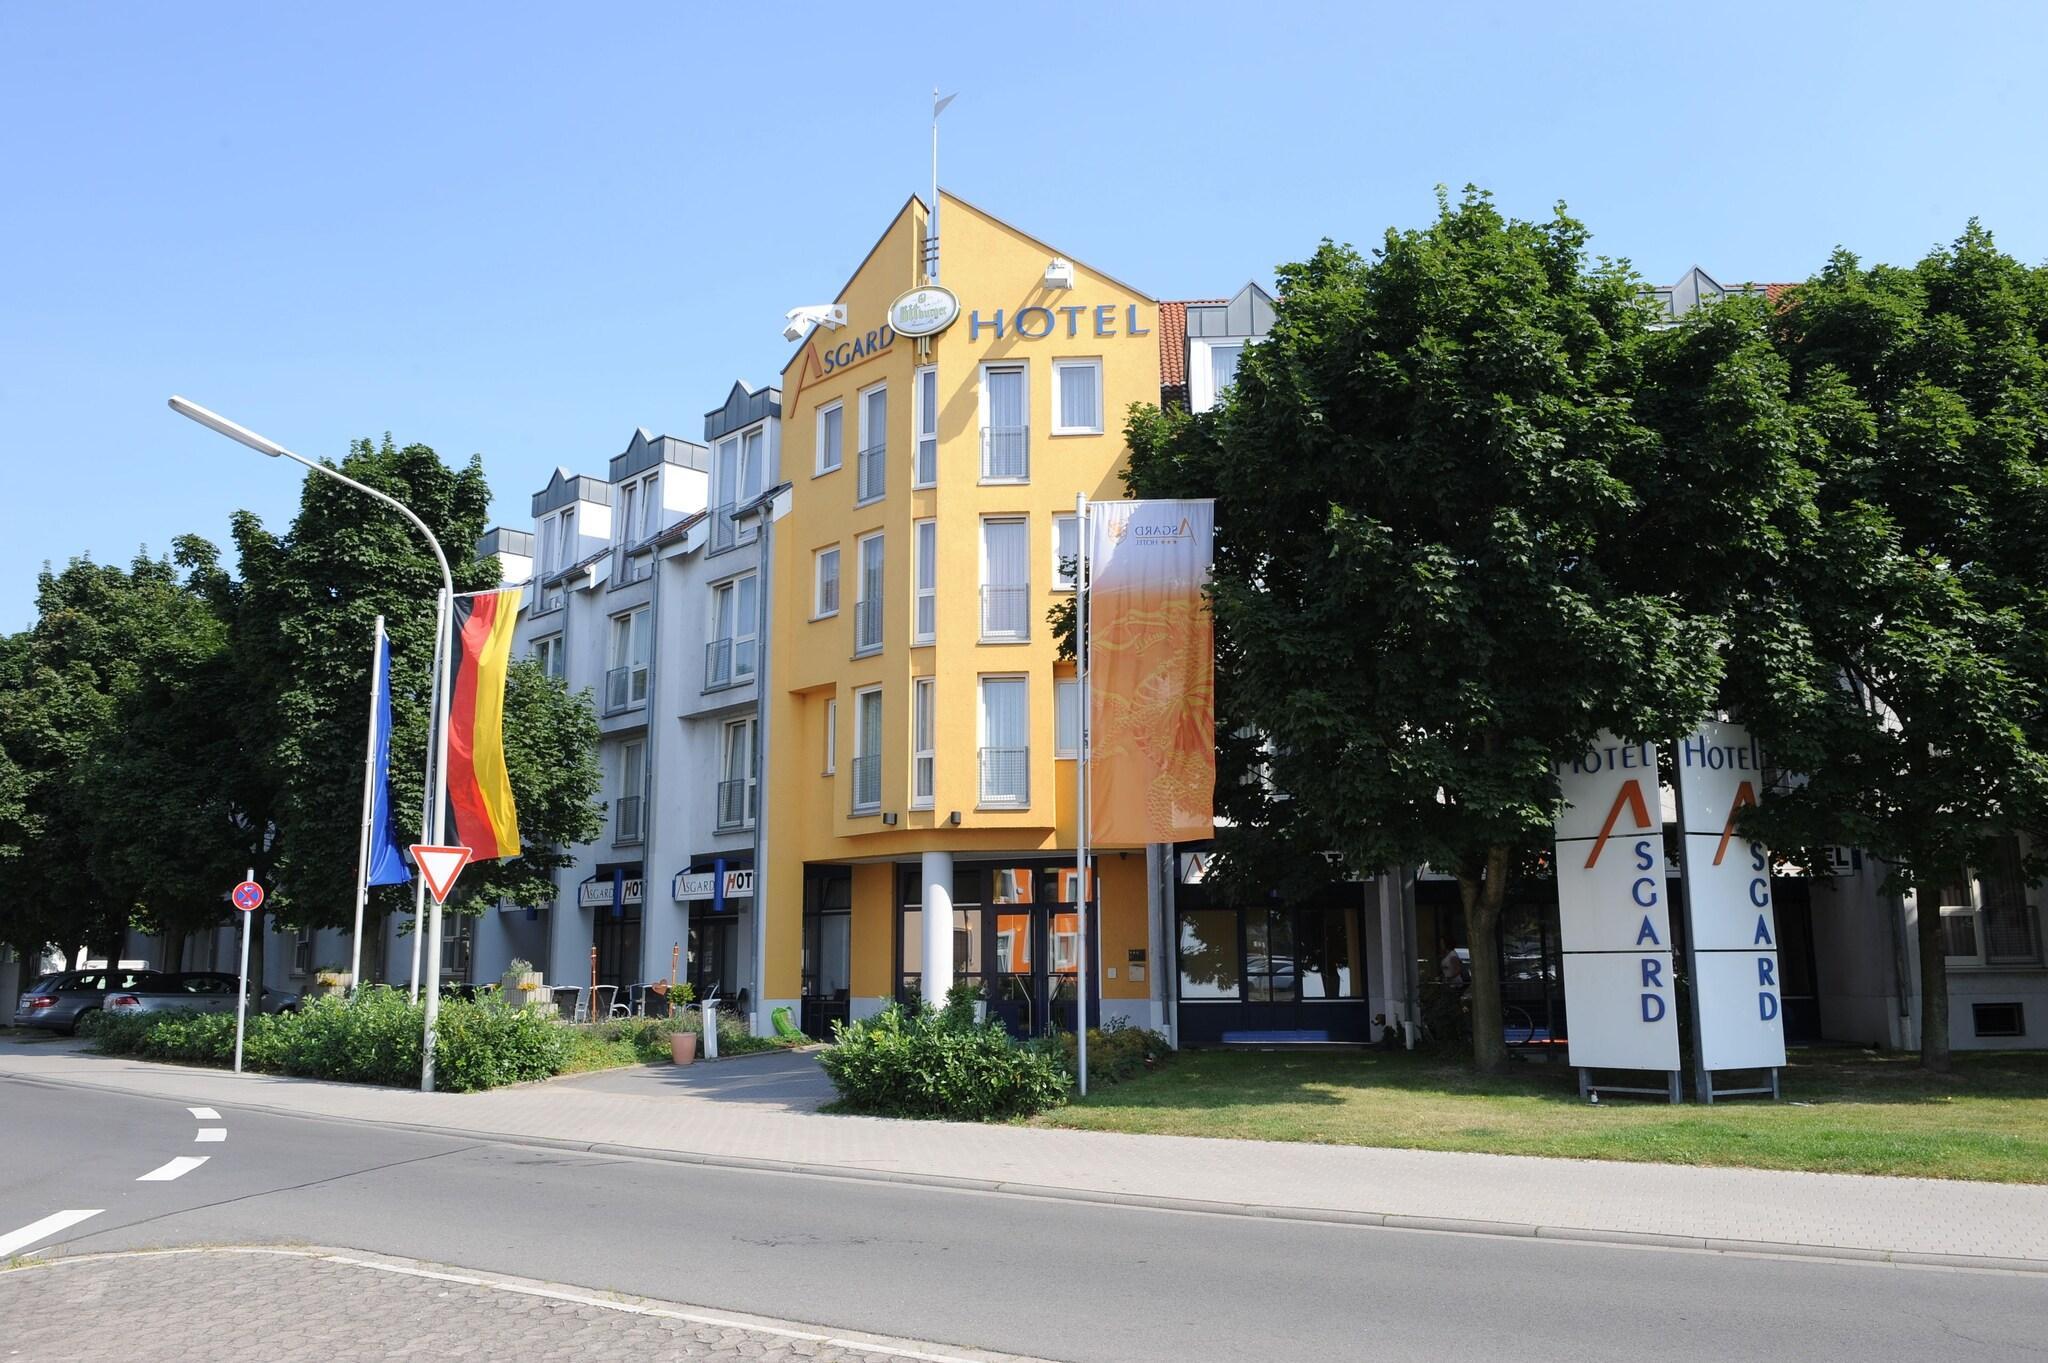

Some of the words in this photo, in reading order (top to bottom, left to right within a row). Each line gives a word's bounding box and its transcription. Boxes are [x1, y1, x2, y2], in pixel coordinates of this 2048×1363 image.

[789, 325, 896, 419] ASGARD
[971, 304, 1151, 341] HOTEL
[676, 876, 715, 899] ASGARD
[725, 872, 753, 898] HOT
[1584, 779, 1666, 1024] ASGARD
